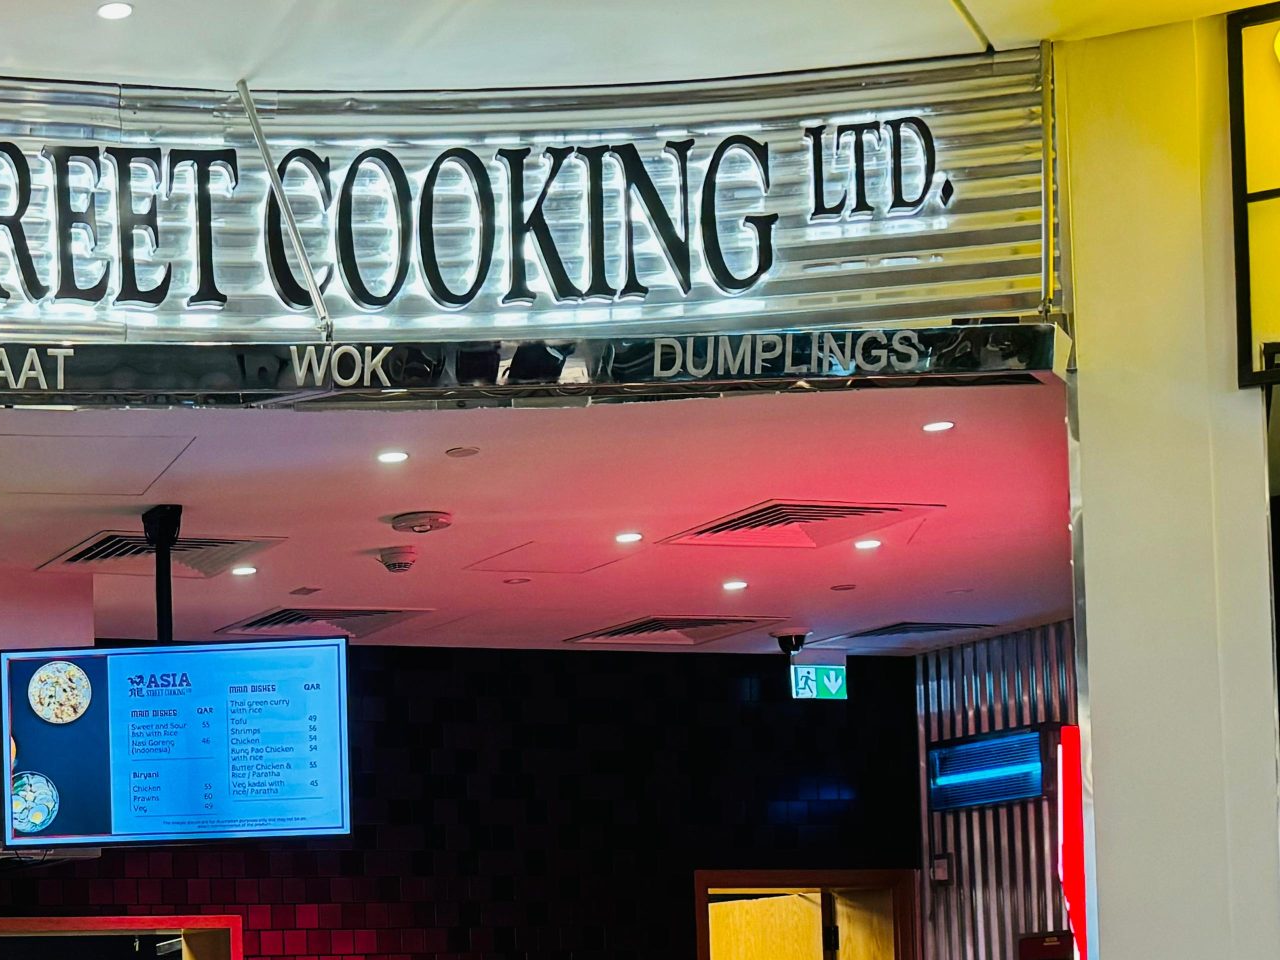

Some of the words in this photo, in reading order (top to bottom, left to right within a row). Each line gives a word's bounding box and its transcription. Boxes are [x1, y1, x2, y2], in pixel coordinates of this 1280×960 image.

[263, 134, 780, 309] COOKING
[805, 117, 955, 219] LTD.
[653, 329, 920, 381] DUMPLINGS
[290, 346, 393, 388] WOK
[146, 673, 192, 688] ASIA
[250, 684, 276, 693] DISHES
[304, 683, 321, 691] QAR
[247, 699, 268, 708] green
[269, 699, 290, 707] curry
[230, 727, 261, 735] Shrimps
[230, 737, 260, 745] Chicken
[265, 745, 294, 753] Chicken
[132, 772, 160, 780] Biryani
